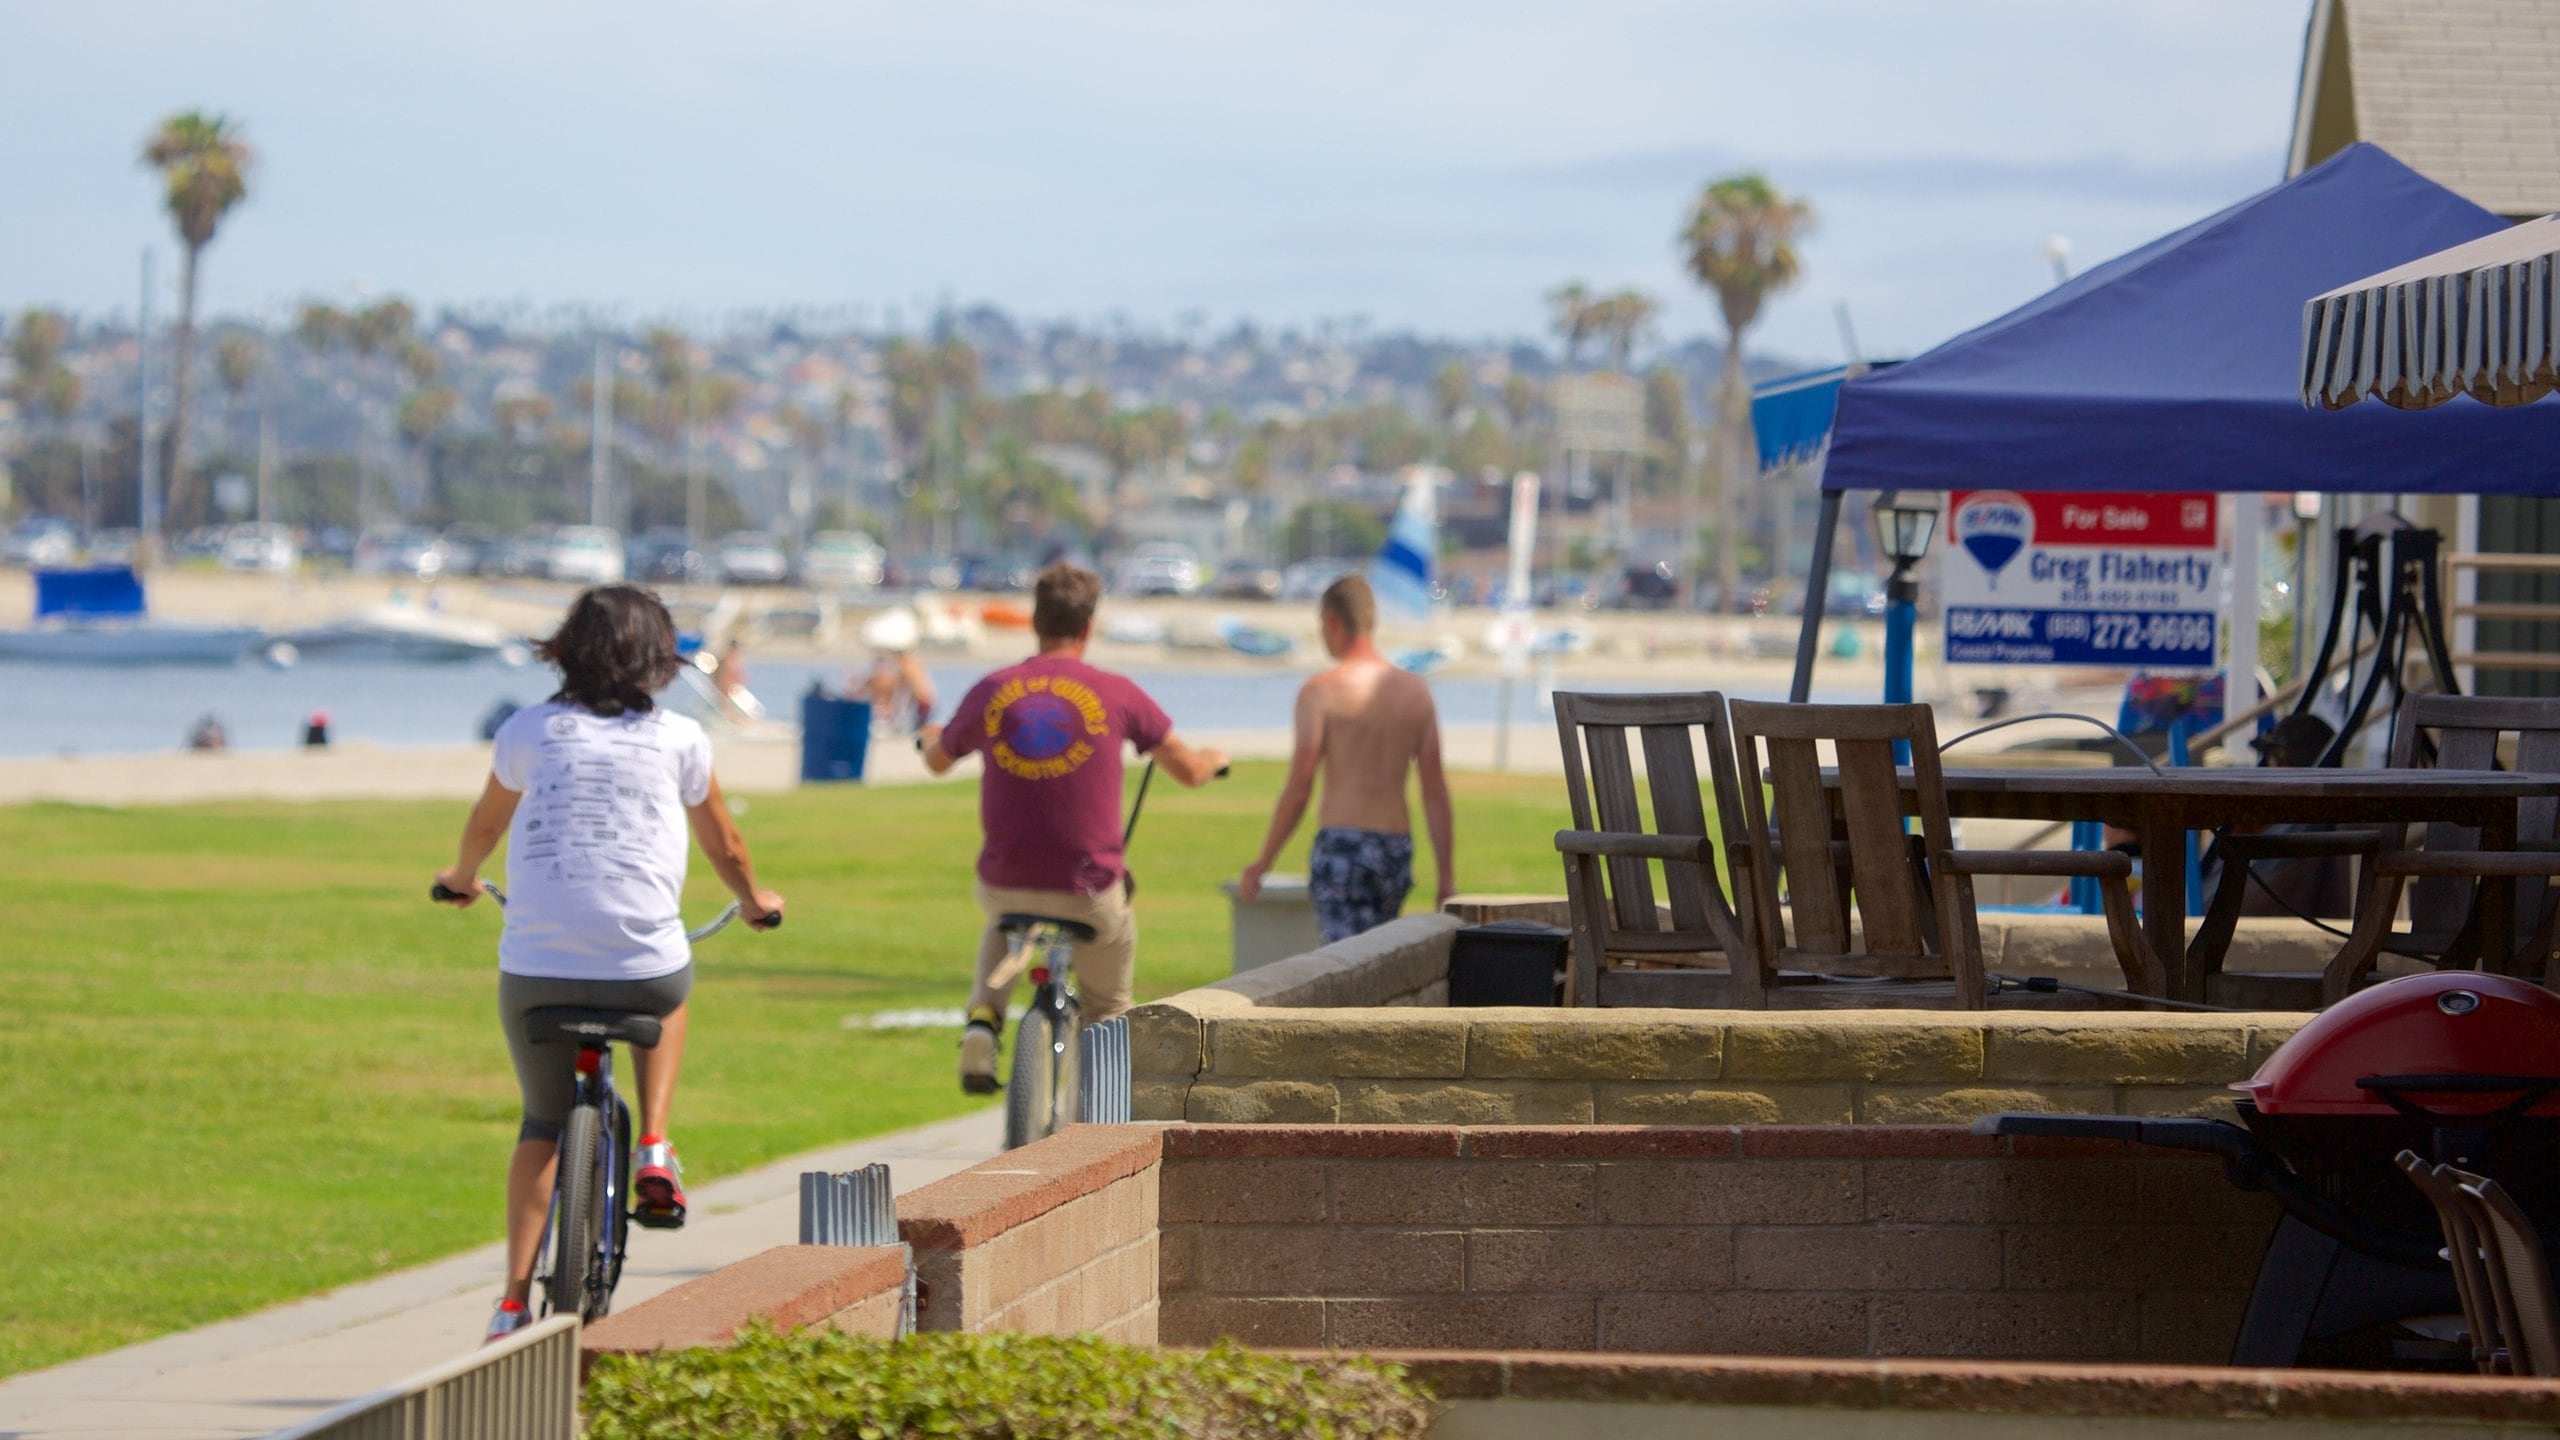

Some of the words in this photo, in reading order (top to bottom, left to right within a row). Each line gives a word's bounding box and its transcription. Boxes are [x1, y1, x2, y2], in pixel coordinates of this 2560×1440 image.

[2063, 504, 2097, 529] For
[2103, 505, 2149, 530] Sale
[2031, 551, 2090, 592] Greg
[2099, 552, 2211, 593] Flaherty
[2093, 614, 2212, 651] 272-9696
